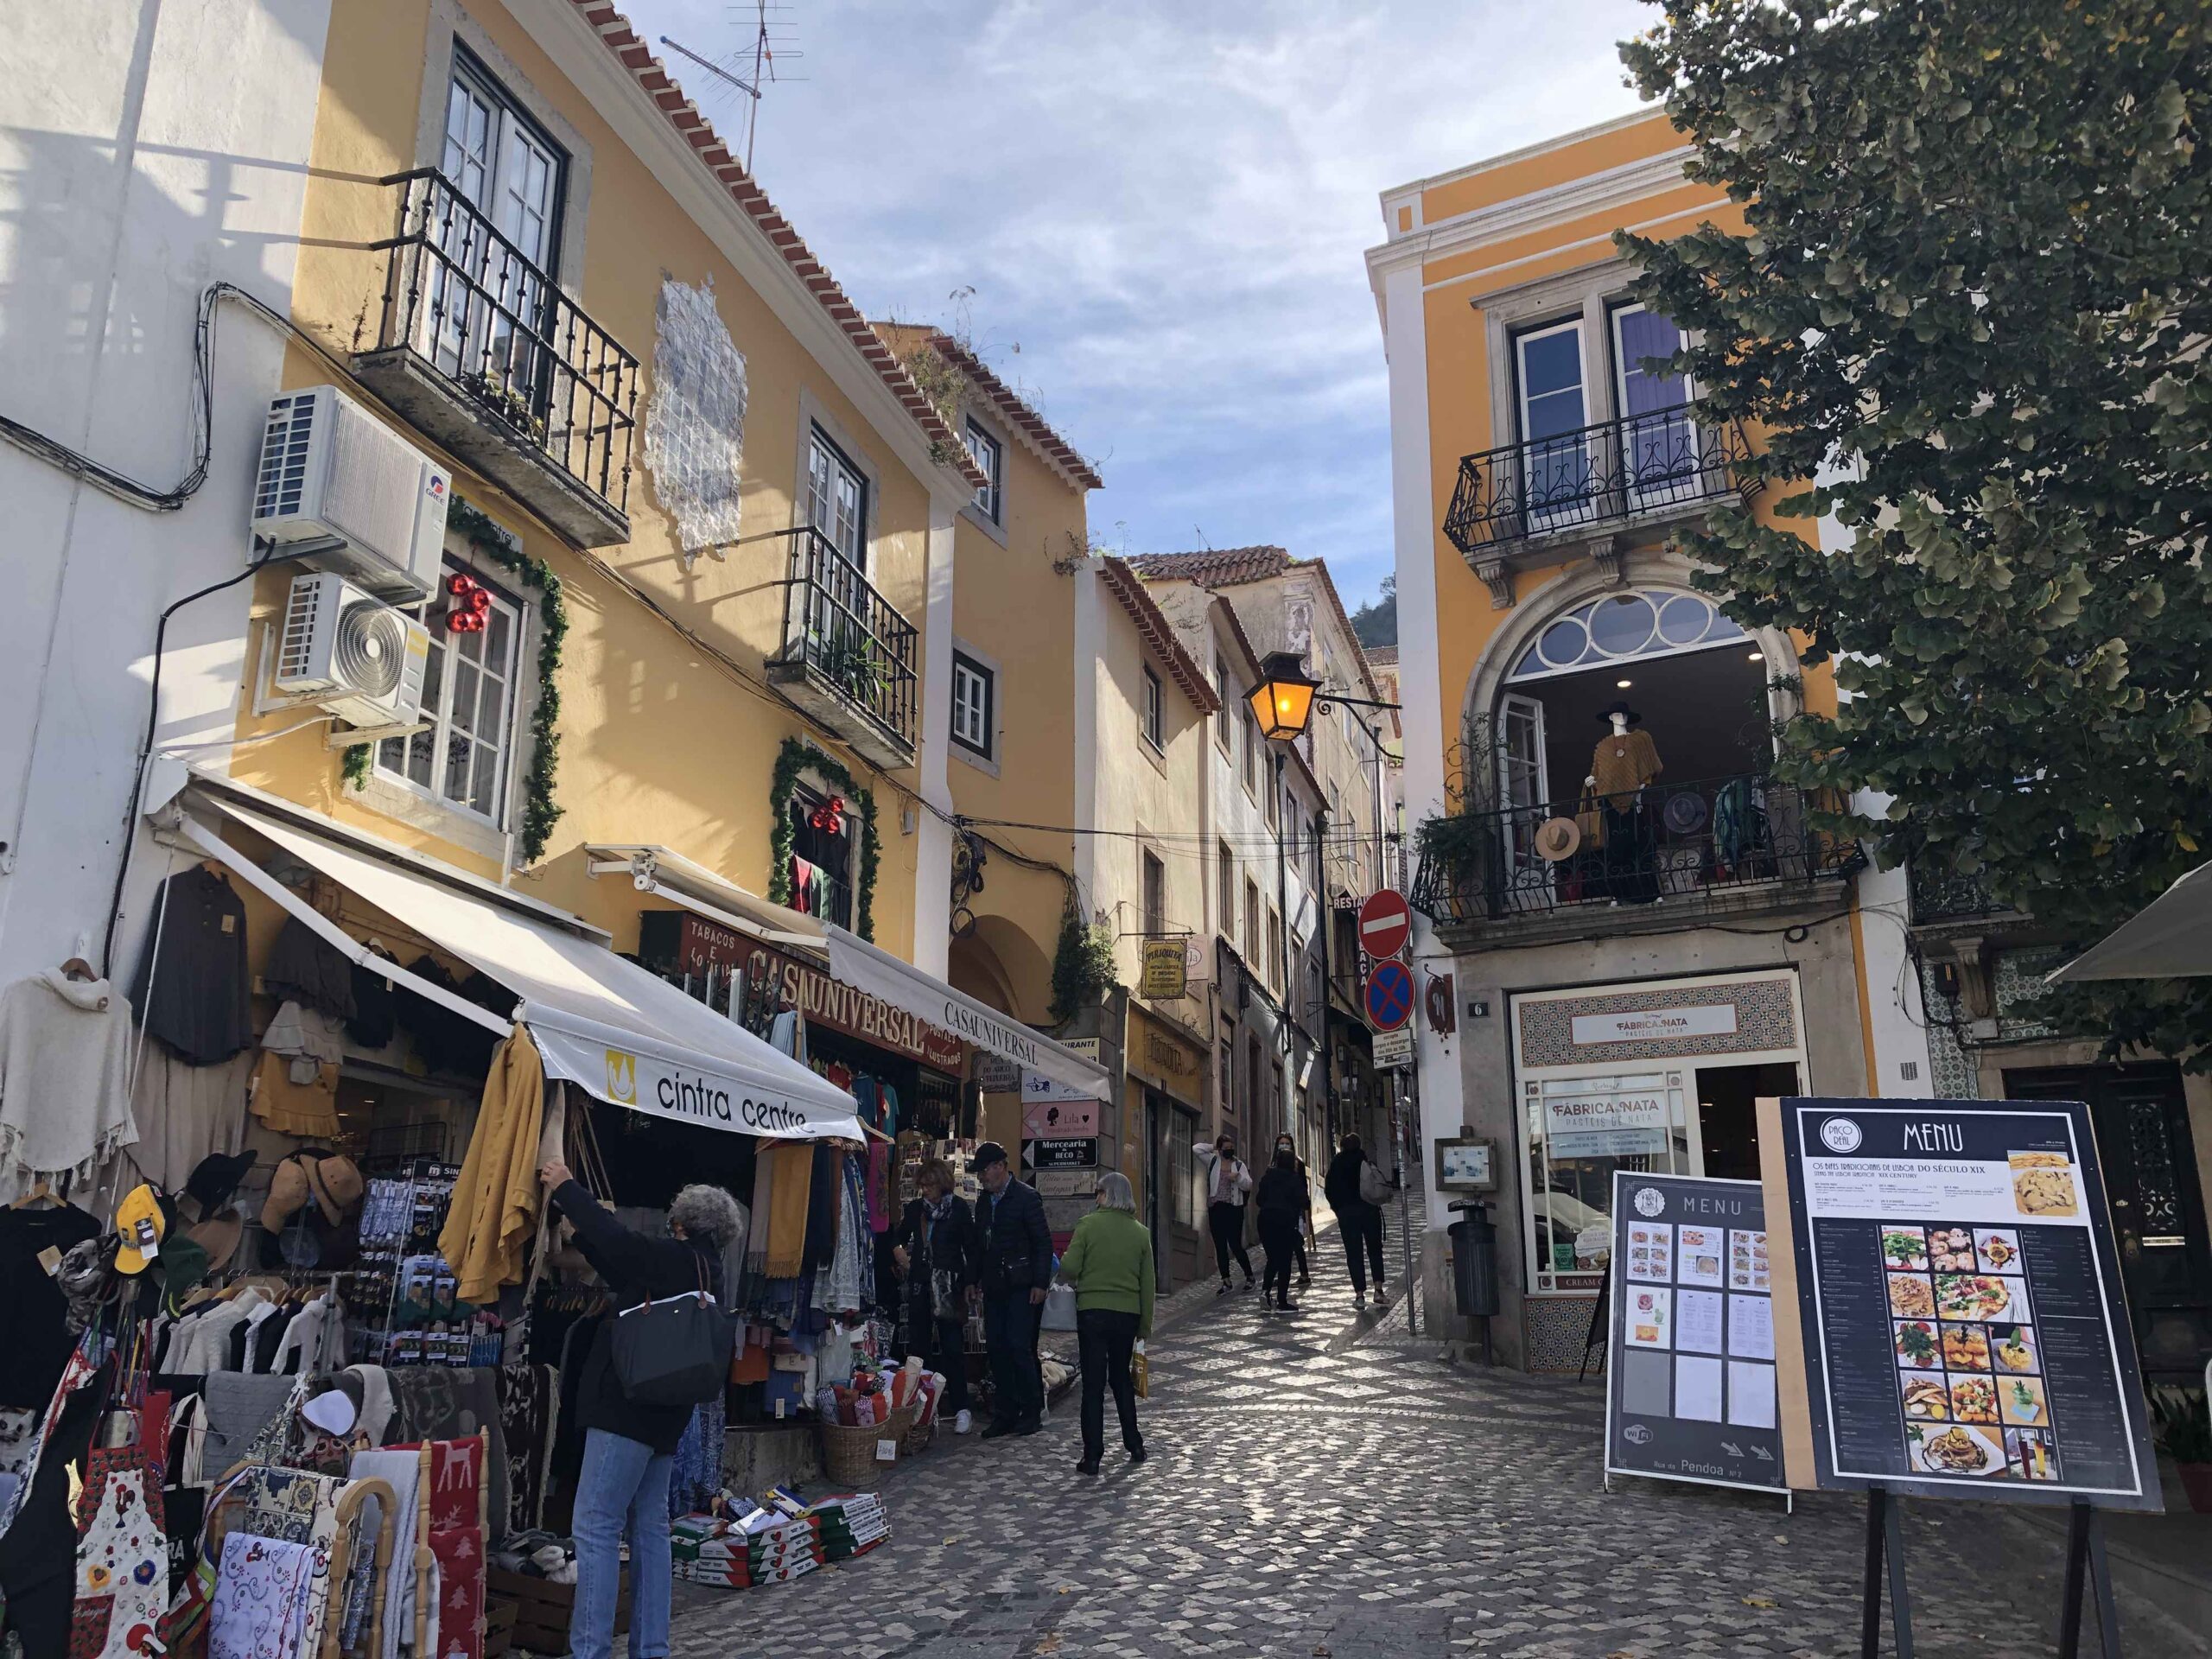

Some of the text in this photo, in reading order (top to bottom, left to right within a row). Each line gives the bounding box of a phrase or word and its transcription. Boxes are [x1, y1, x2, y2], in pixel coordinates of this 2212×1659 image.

[426, 487, 445, 505] GREE
[692, 921, 735, 950] TABACOS
[709, 945, 717, 959] E
[1146, 947, 1183, 963] PIRIQUITA
[1474, 1003, 1483, 1016] 6
[1617, 1019, 1658, 1031] FÁBRICA
[1662, 1018, 1688, 1027] NATA
[1060, 1040, 1096, 1049] URANTE
[926, 1045, 961, 1065] ILUSTRADOS
[657, 1072, 816, 1134] cintra centre
[1553, 1103, 1614, 1117] FÁBRICA
[1619, 1099, 1659, 1113] NATA
[1064, 1113, 1079, 1125] Lila
[1628, 1114, 1652, 1123] NATA
[1828, 1125, 1853, 1136] PAÇO
[1042, 1140, 1087, 1148] Mercearia
[1834, 1136, 1851, 1146] REAL
[1904, 1123, 1963, 1152] MENU
[1825, 1162, 1839, 1171] BIFES
[1917, 1164, 1931, 1173] DO
[1933, 1163, 1968, 1173] SÉCULO
[1684, 1197, 1741, 1216] MENU
[1566, 1278, 1594, 1287] CREAM
[1654, 1460, 1666, 1469] Rua
[1681, 1459, 1724, 1477] Pendoa
